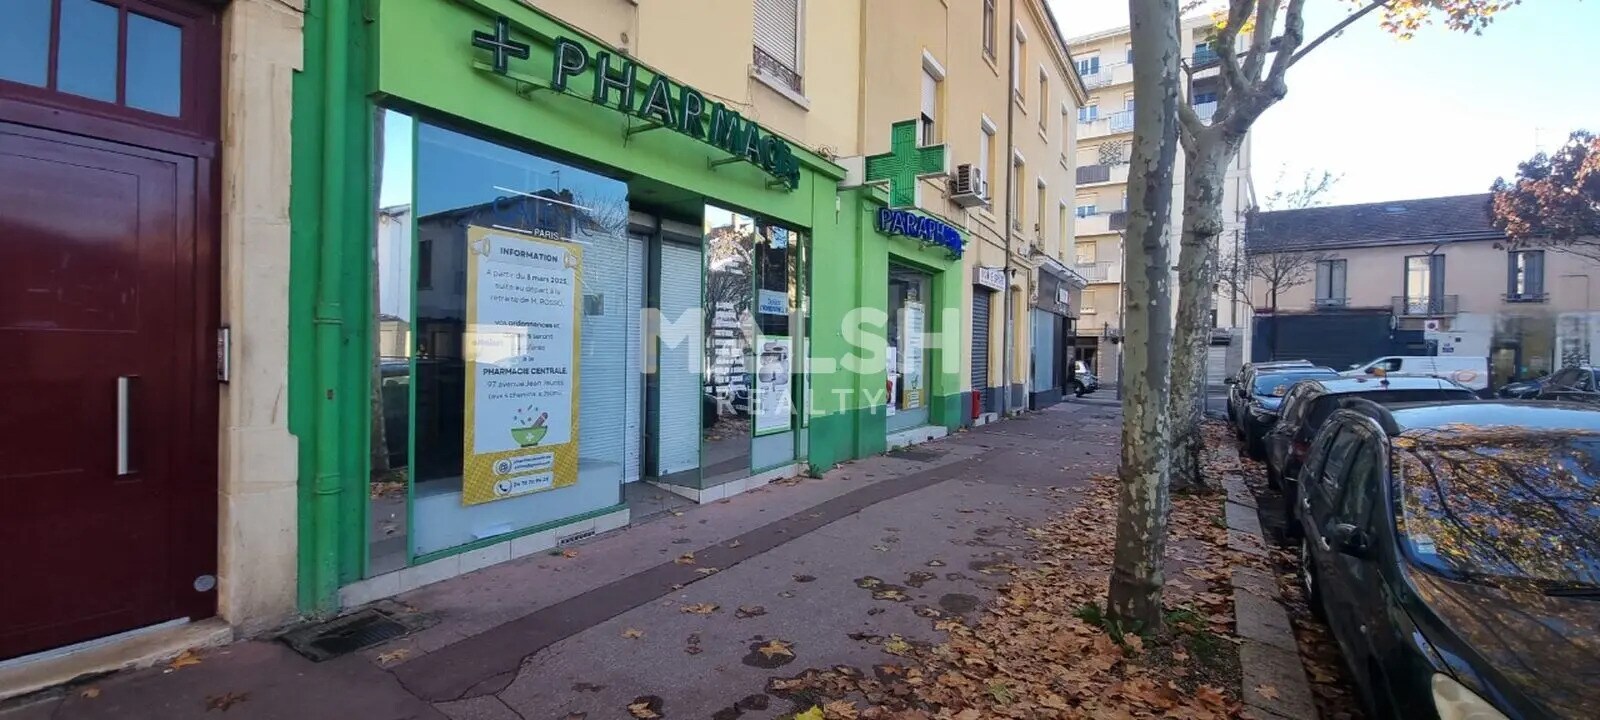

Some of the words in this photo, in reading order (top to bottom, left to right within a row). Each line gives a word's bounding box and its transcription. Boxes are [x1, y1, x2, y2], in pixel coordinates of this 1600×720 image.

[551, 35, 800, 189] PHARMAC
[533, 228, 560, 241] PARIS
[500, 247, 558, 263] INFORMATION
[516, 271, 525, 280] du
[483, 367, 529, 376] PHARMACIE
